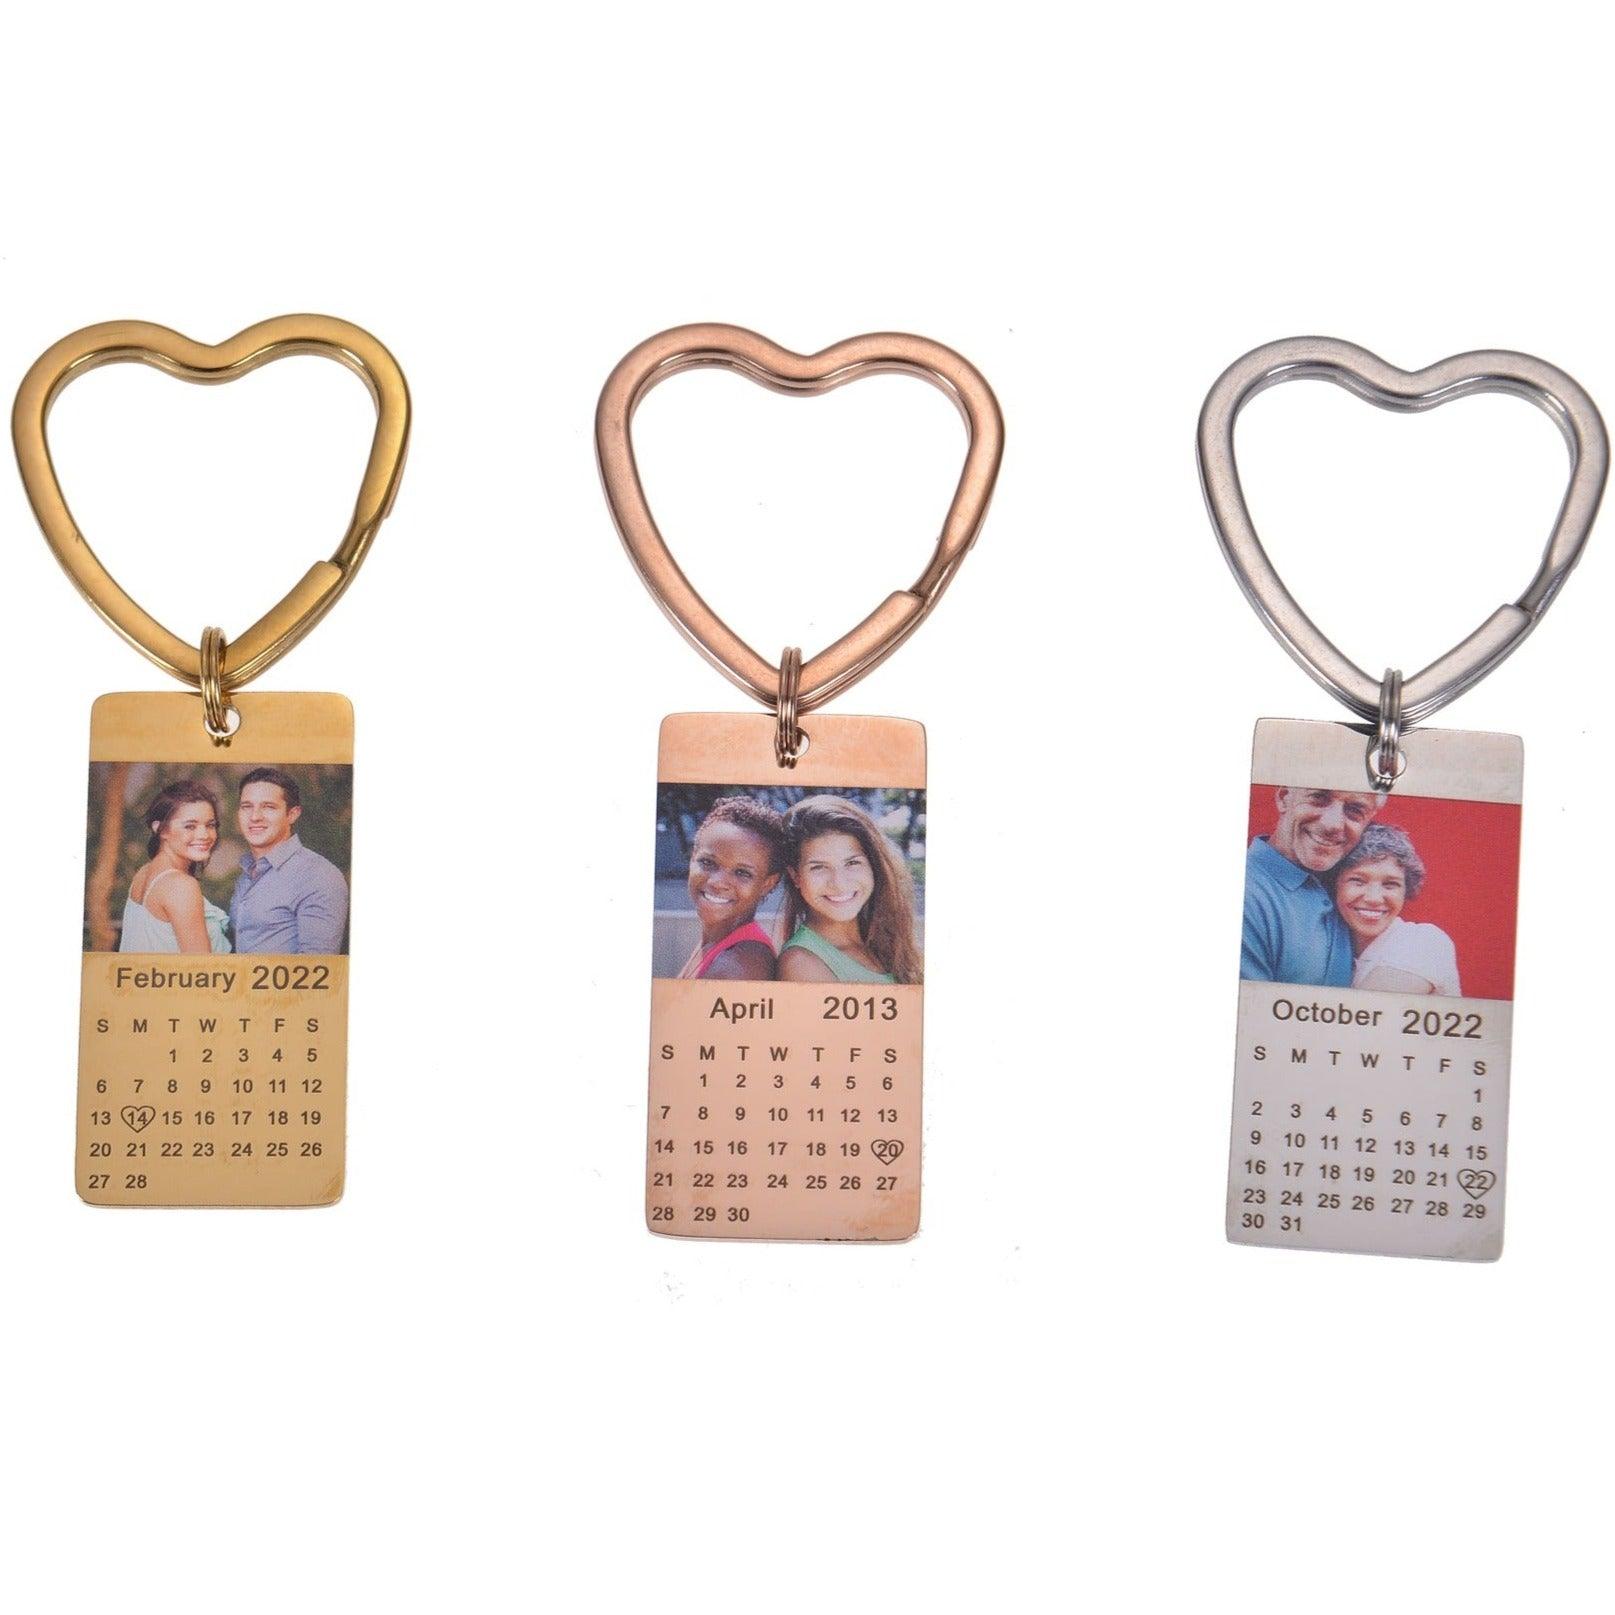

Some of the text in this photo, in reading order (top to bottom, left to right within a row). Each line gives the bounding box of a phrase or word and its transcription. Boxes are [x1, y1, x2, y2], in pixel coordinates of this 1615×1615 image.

[117, 965, 329, 993] February 2022
[709, 996, 898, 1024] April 2013
[1273, 999, 1482, 1039] October 2022
[97, 1018, 318, 1033] S M T W T F S
[169, 1048, 317, 1063] 1 2 3 4 5
[661, 1044, 897, 1063] S M T W T F S
[1253, 1045, 1486, 1076] S M T W T F S
[96, 1079, 322, 1093] 6 7 8 9 10 11 12
[700, 1073, 893, 1090] 1 2 3 4 5 6
[1474, 1089, 1481, 1103] 1
[91, 1110, 321, 1126] 13 14 15 16 17 18 19
[661, 1106, 897, 1123] 7 8 9 10 11 12 13
[1251, 1101, 1483, 1131] 2 3 4 5 6 7 8
[89, 1142, 322, 1157] 20 21 22 23 24 25 26
[654, 1139, 898, 1158] 14 15 16 17 18 19 20
[1250, 1130, 1487, 1160] 9 10 11 12 13 14 15
[88, 1174, 147, 1189] 27 28
[653, 1172, 897, 1191] 21 22 23 24 25 26 27
[1245, 1159, 1486, 1190] 16 17 18 19 20 21 22
[1243, 1188, 1486, 1219] 23 24 25 26 27 28 29
[652, 1206, 749, 1222] 28 29 30
[1242, 1213, 1301, 1232] 30 31
